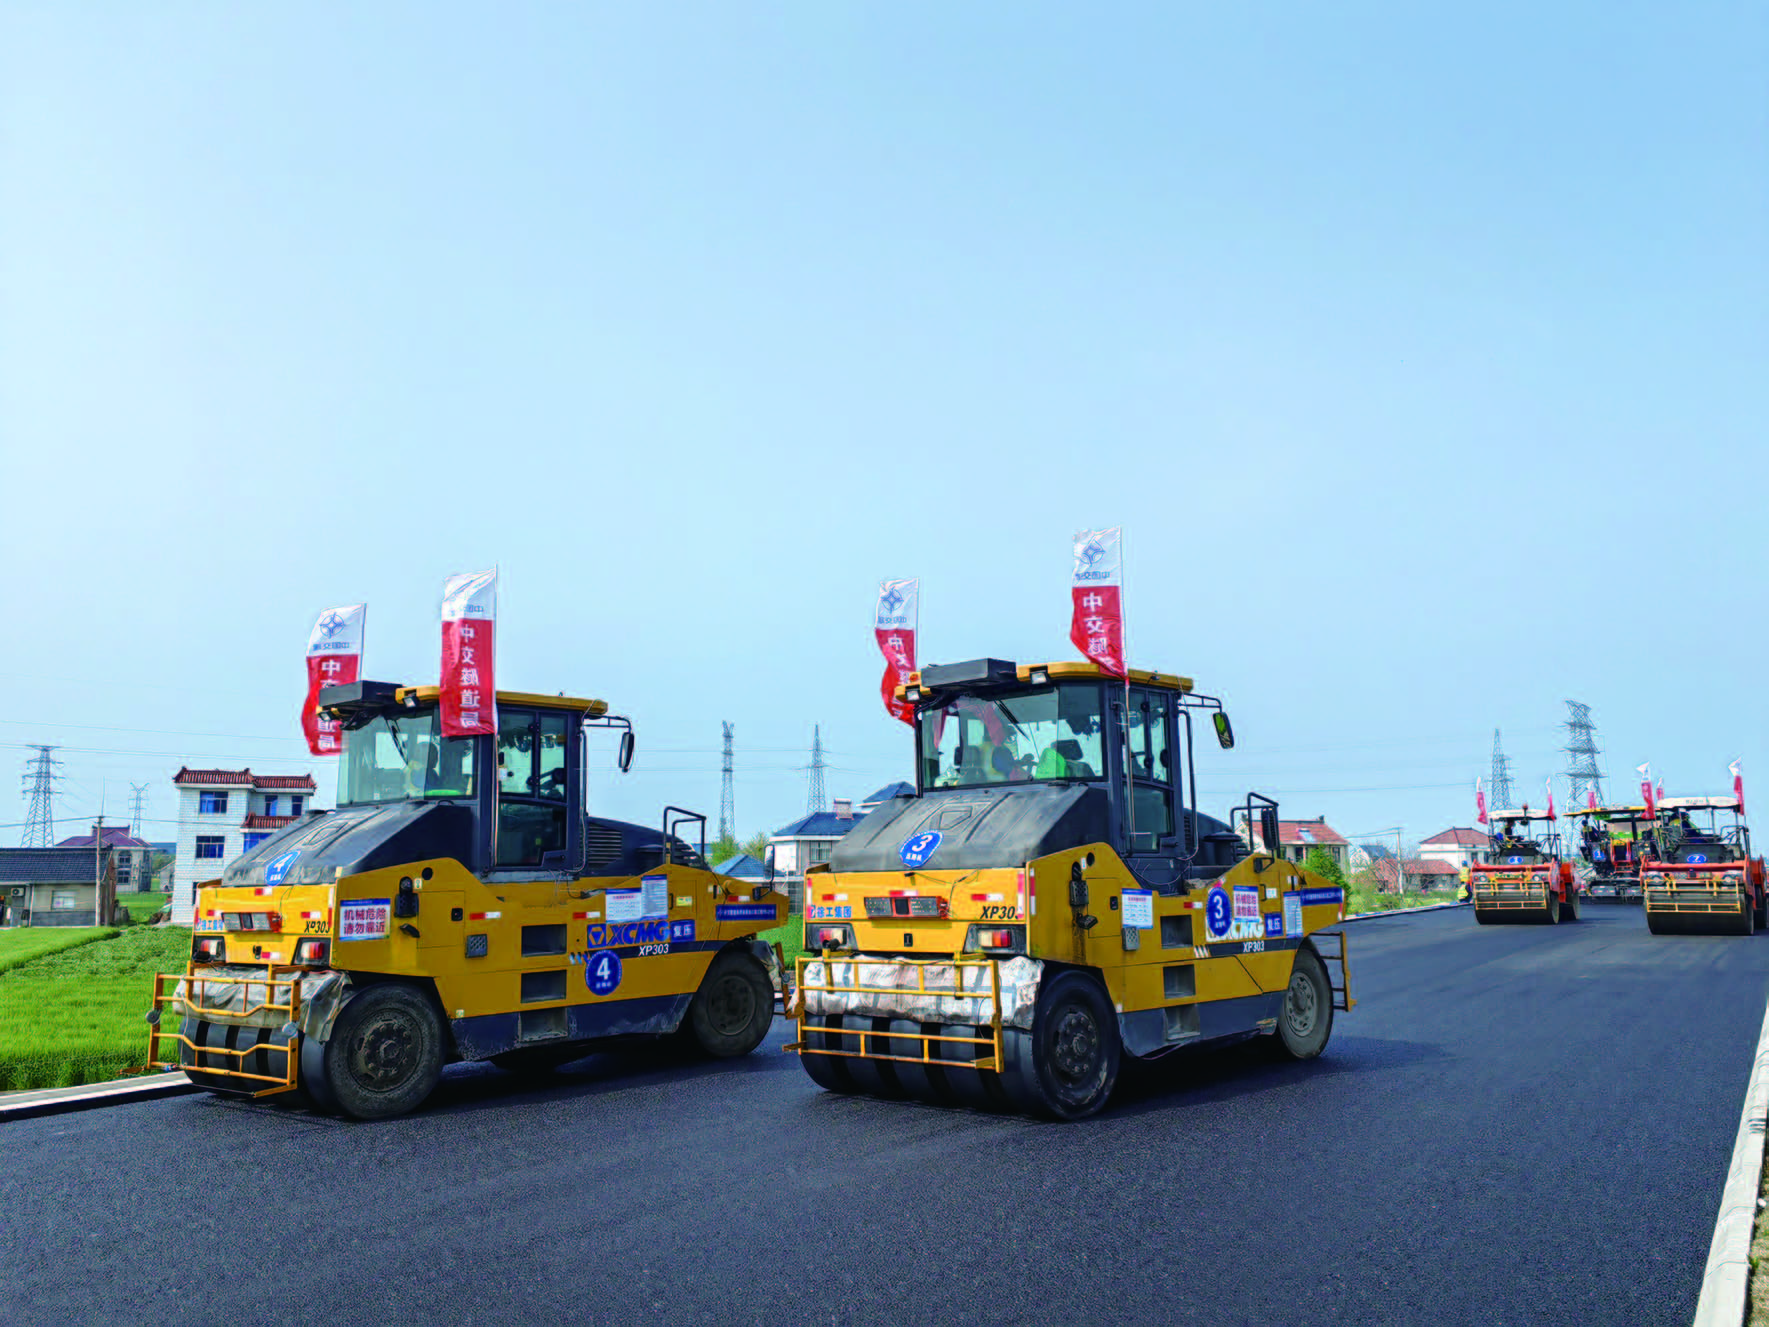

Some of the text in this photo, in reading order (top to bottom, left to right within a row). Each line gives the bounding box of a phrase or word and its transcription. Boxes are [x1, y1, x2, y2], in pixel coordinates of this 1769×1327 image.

[911, 835, 933, 851] 3
[274, 854, 293, 871] 4
[344, 908, 386, 921] 机械危险
[816, 906, 852, 918] 徐工集团
[980, 905, 1018, 919] XP30
[1213, 895, 1223, 919] 3
[608, 921, 669, 946] XCMG
[1229, 915, 1264, 939] CMG
[638, 943, 669, 956] XP303
[1242, 940, 1265, 953] XP303
[596, 957, 611, 980] 4
